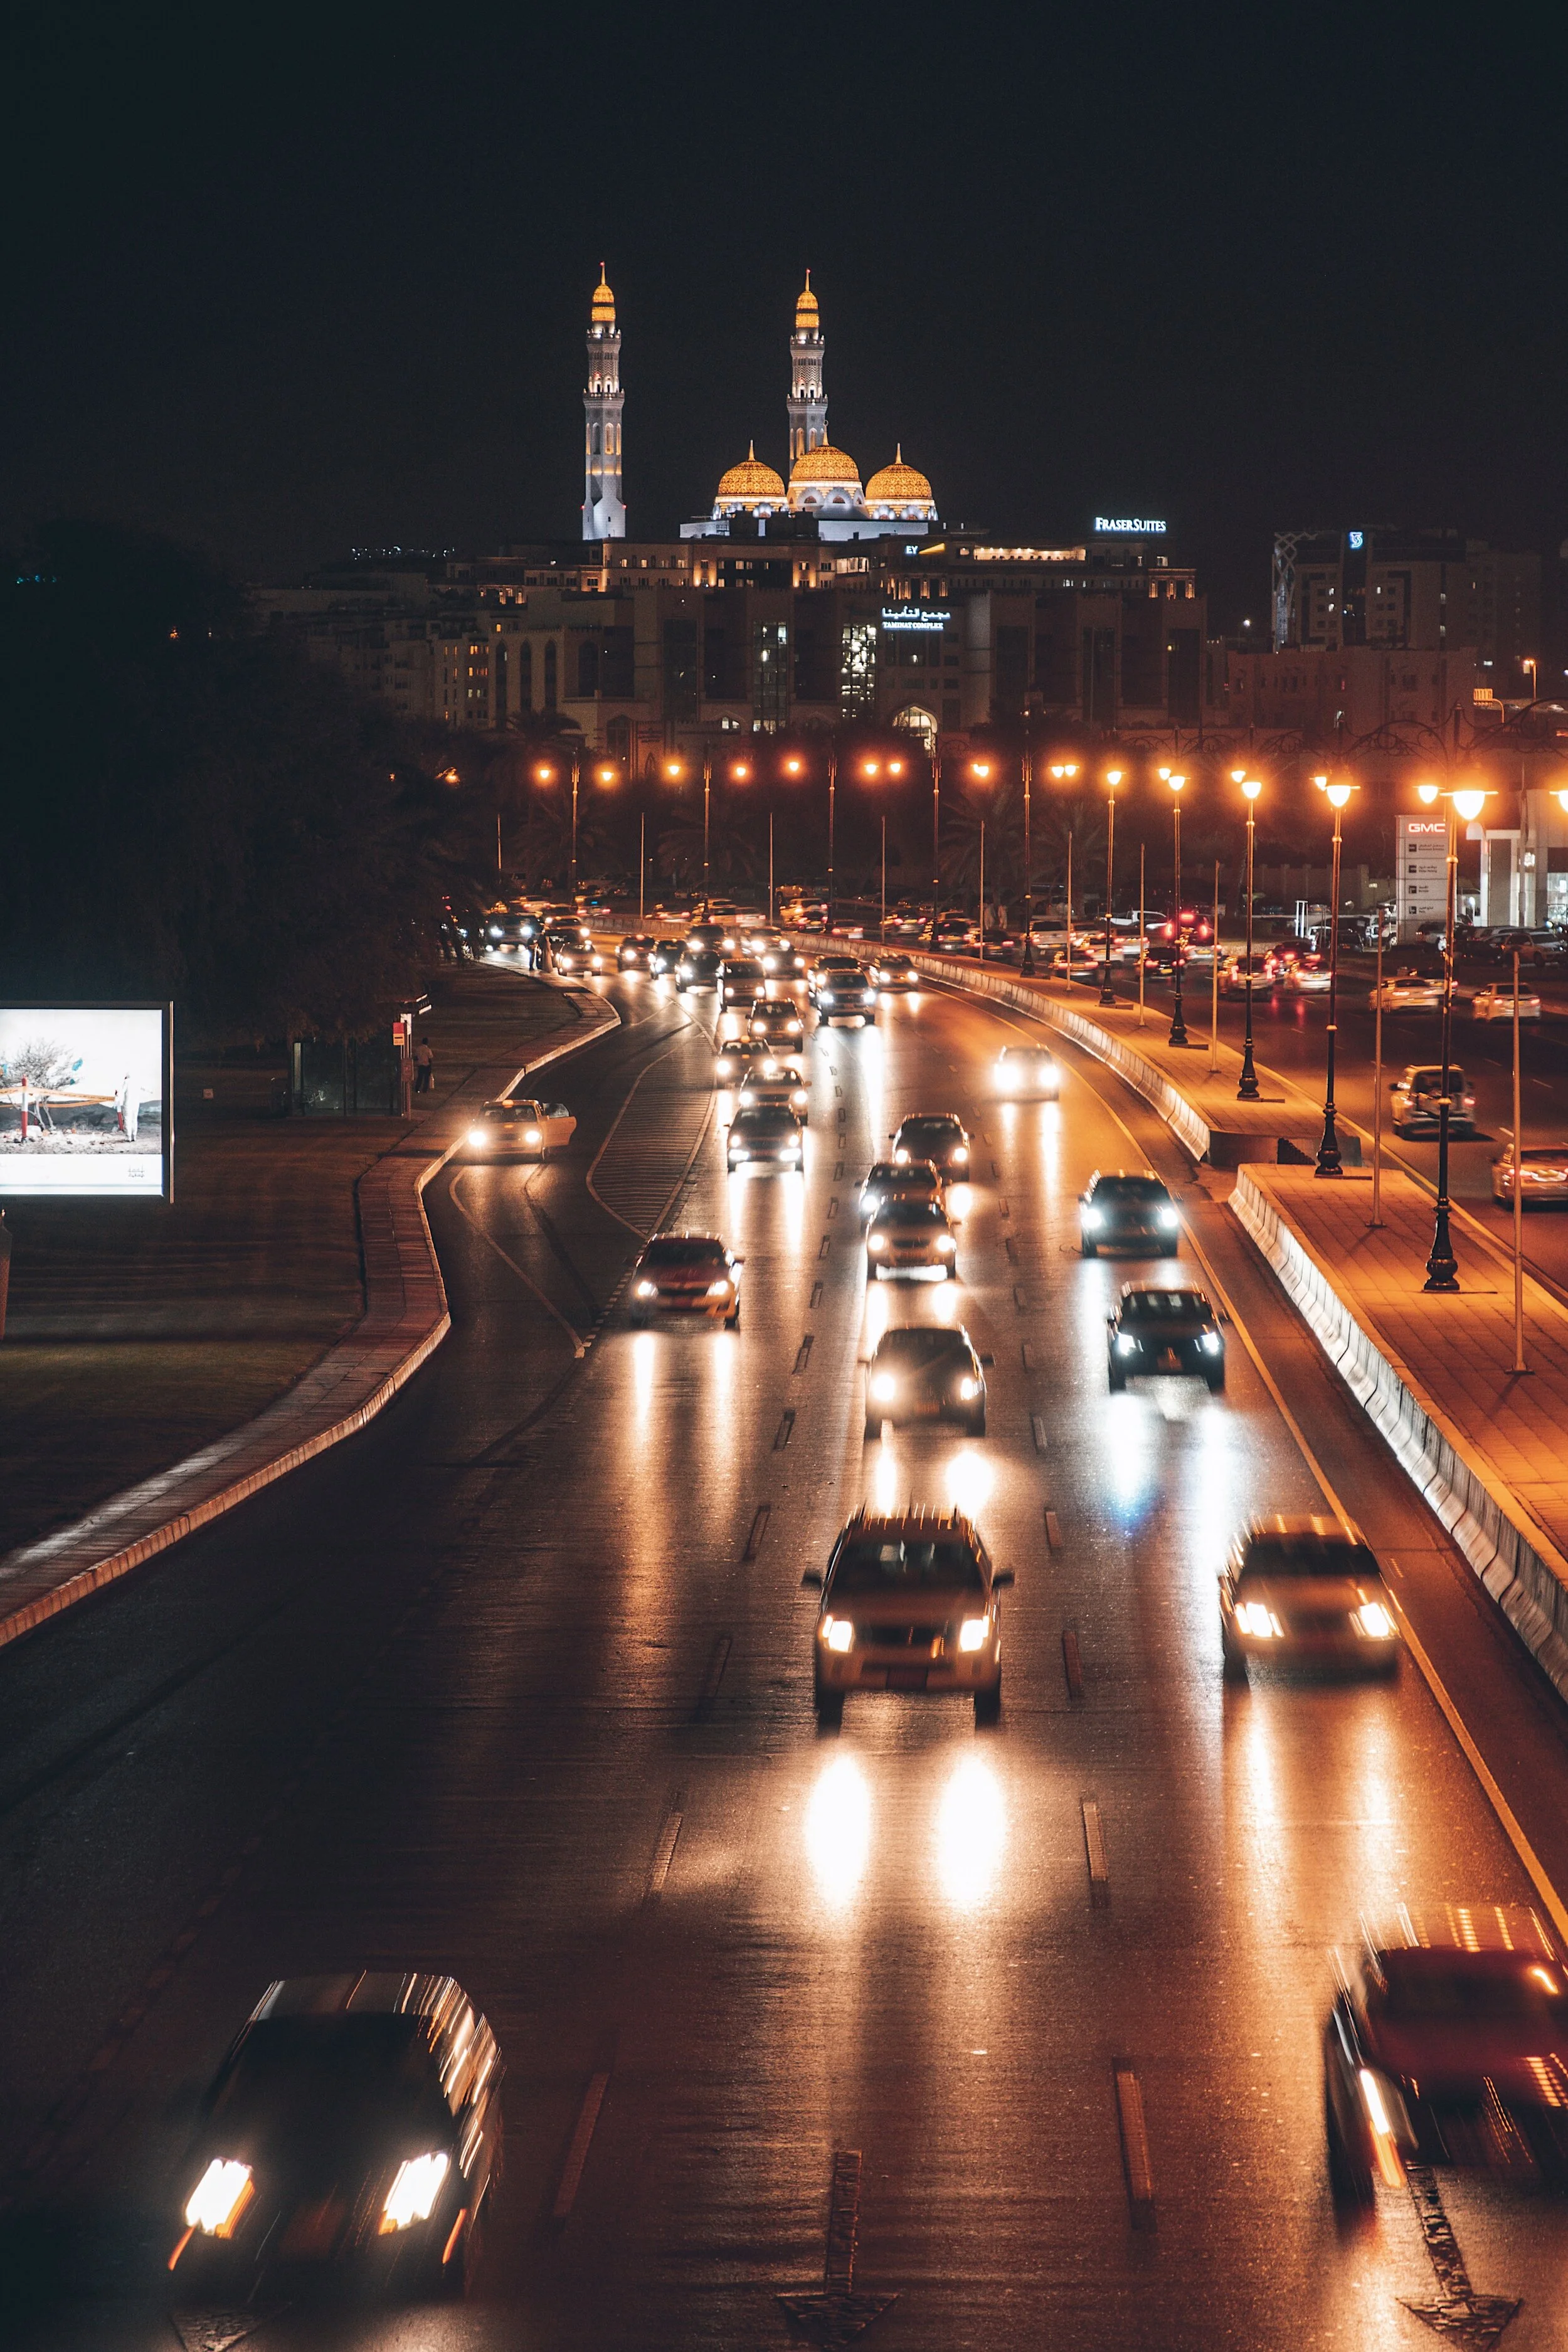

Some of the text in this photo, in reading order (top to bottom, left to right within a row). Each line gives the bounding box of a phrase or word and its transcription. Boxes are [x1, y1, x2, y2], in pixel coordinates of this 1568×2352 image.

[906, 545, 918, 554] EY
[921, 611, 950, 622] مجمع
[882, 622, 943, 630] TAMINAT COMPLEX
[1408, 823, 1446, 832] GMC
